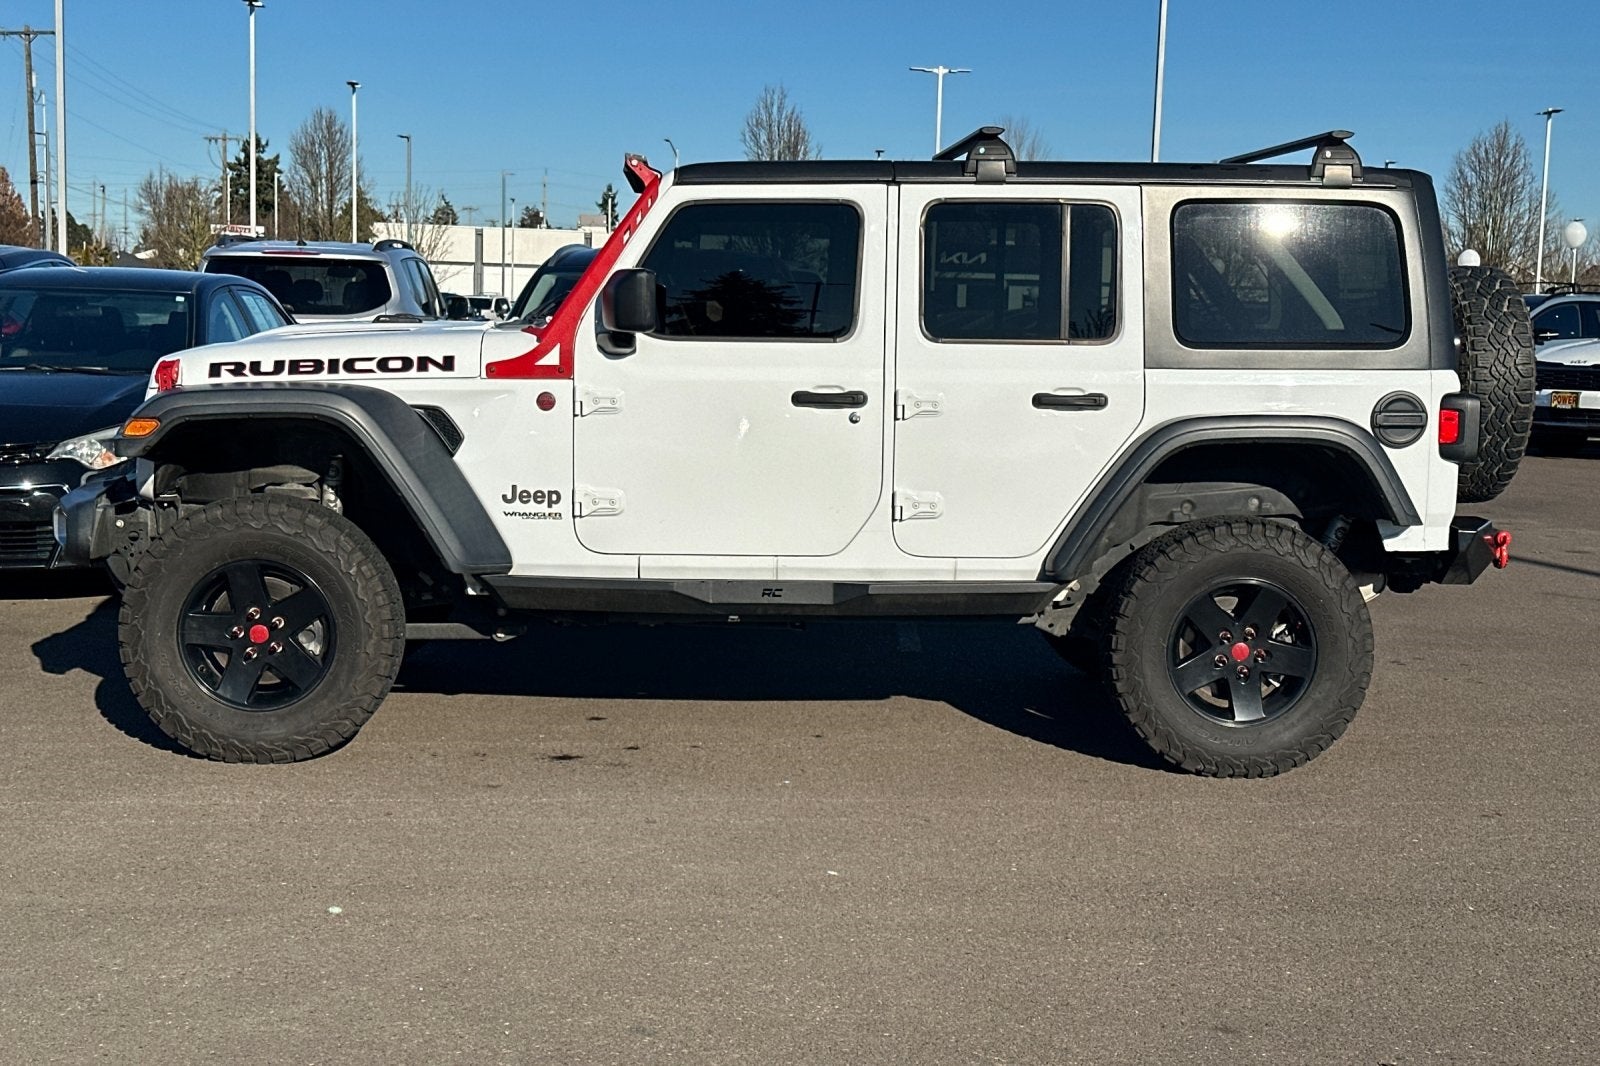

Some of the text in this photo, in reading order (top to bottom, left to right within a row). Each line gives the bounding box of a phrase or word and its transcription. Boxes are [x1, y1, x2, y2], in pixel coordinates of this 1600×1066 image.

[208, 355, 456, 378] RUBICON
[1552, 394, 1578, 405] POWER
[501, 484, 562, 509] Jeep
[761, 588, 783, 598] RC
